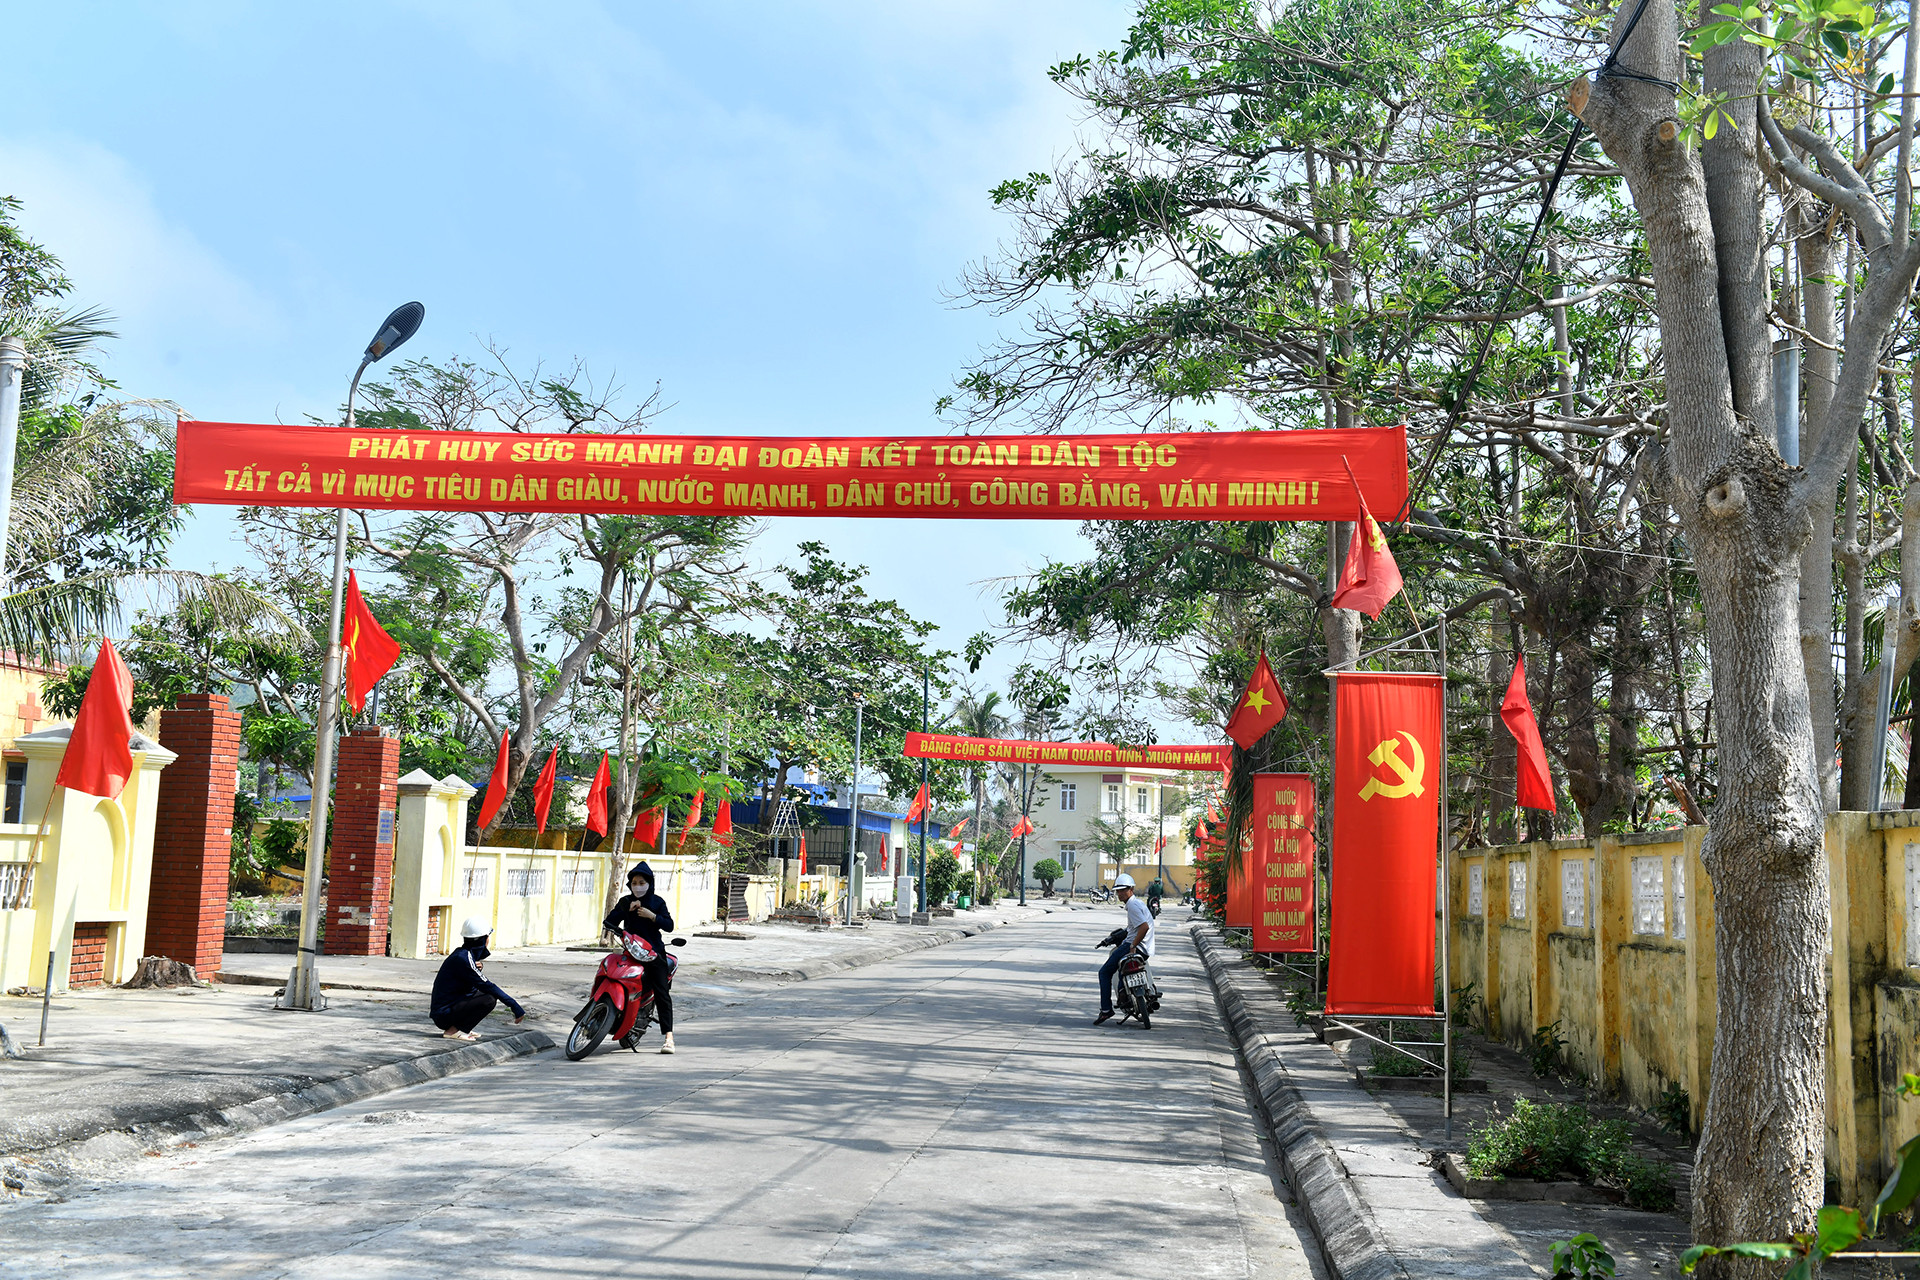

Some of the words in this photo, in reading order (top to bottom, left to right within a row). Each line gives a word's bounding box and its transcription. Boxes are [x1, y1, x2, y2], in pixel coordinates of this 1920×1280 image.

[348, 435, 431, 460] PHÁT
[438, 440, 502, 461] HUY
[510, 438, 575, 462] SỨC
[585, 442, 684, 467] MẠNH
[693, 445, 748, 471] ĐẠI
[758, 443, 849, 468] ĐOÀN
[861, 442, 921, 467] KẾT
[931, 442, 1019, 466] TOÀN
[1031, 441, 1100, 467] DÂN
[1113, 441, 1177, 472] TỘC
[224, 463, 271, 491] TẤT
[277, 463, 312, 494] CẢ
[322, 469, 346, 496] VÌ
[354, 474, 414, 503] MỤC
[424, 473, 481, 501] TIÊU
[491, 474, 548, 502] DÂN
[557, 473, 628, 504] GIÀU,
[639, 474, 714, 505] NƯỚC
[724, 483, 816, 509] MẠNH,
[827, 479, 884, 507] DÂN
[895, 473, 959, 508] CHỦ,
[970, 477, 1048, 506] CÔNG
[1058, 473, 1149, 509] BẰNG,
[1159, 479, 1217, 507] VĂN
[920, 736, 951, 754] ĐẢNG
[954, 741, 985, 757] CỘNG
[988, 741, 1012, 757] SẢN
[1015, 744, 1039, 761] VIỆT
[1041, 748, 1068, 760] NAM
[1071, 748, 1112, 762] QUANG
[1115, 749, 1142, 762] VINH
[1146, 749, 1181, 763] MUÔN
[1184, 750, 1212, 764] NĂM
[1275, 787, 1296, 805] NƯỚC
[1267, 812, 1288, 832] CỘNG
[1290, 812, 1305, 829] HÒA
[1286, 836, 1300, 857] HỘI
[1266, 857, 1282, 878] CHỦ
[1283, 860, 1306, 878] NGHĨA
[1266, 884, 1282, 905] VIỆT
[1284, 887, 1302, 902] NAM
[1263, 908, 1286, 926] MUÔN
[1287, 908, 1306, 926] NĂM
